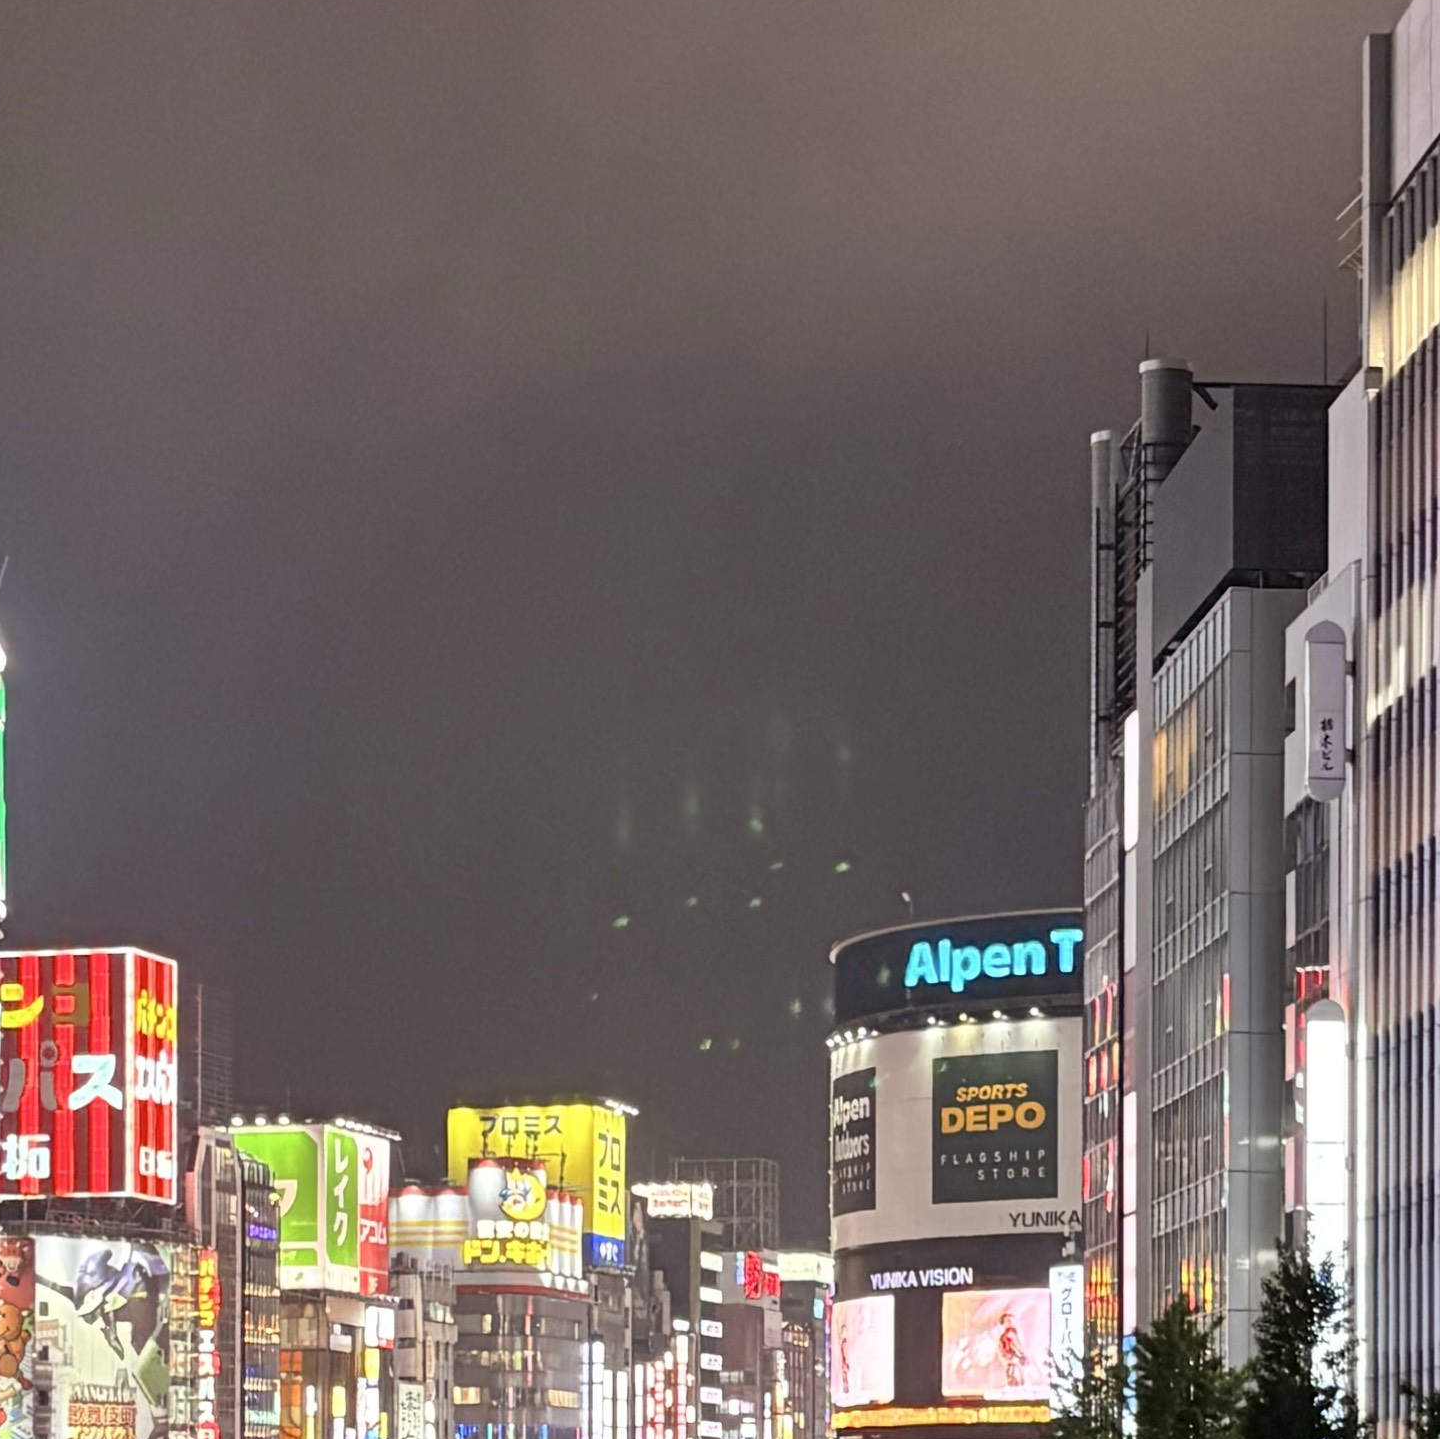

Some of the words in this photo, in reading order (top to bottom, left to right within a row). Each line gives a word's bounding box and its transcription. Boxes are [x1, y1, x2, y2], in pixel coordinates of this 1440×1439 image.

[904, 938, 1046, 993] Alpen
[956, 1082, 1029, 1103] SPORTS
[478, 1114, 563, 1136] プロミス
[833, 1095, 871, 1132] Alpen
[940, 1101, 1047, 1135] DEPO
[940, 1149, 1047, 1166] FLAGSHIP
[977, 1168, 1047, 1181] STORE
[333, 1137, 350, 1247] レイク
[360, 1218, 388, 1245] アコム
[1009, 1211, 1082, 1228] YUNIKA
[870, 1270, 918, 1291] YUNIKA
[920, 1266, 974, 1288] VISION
